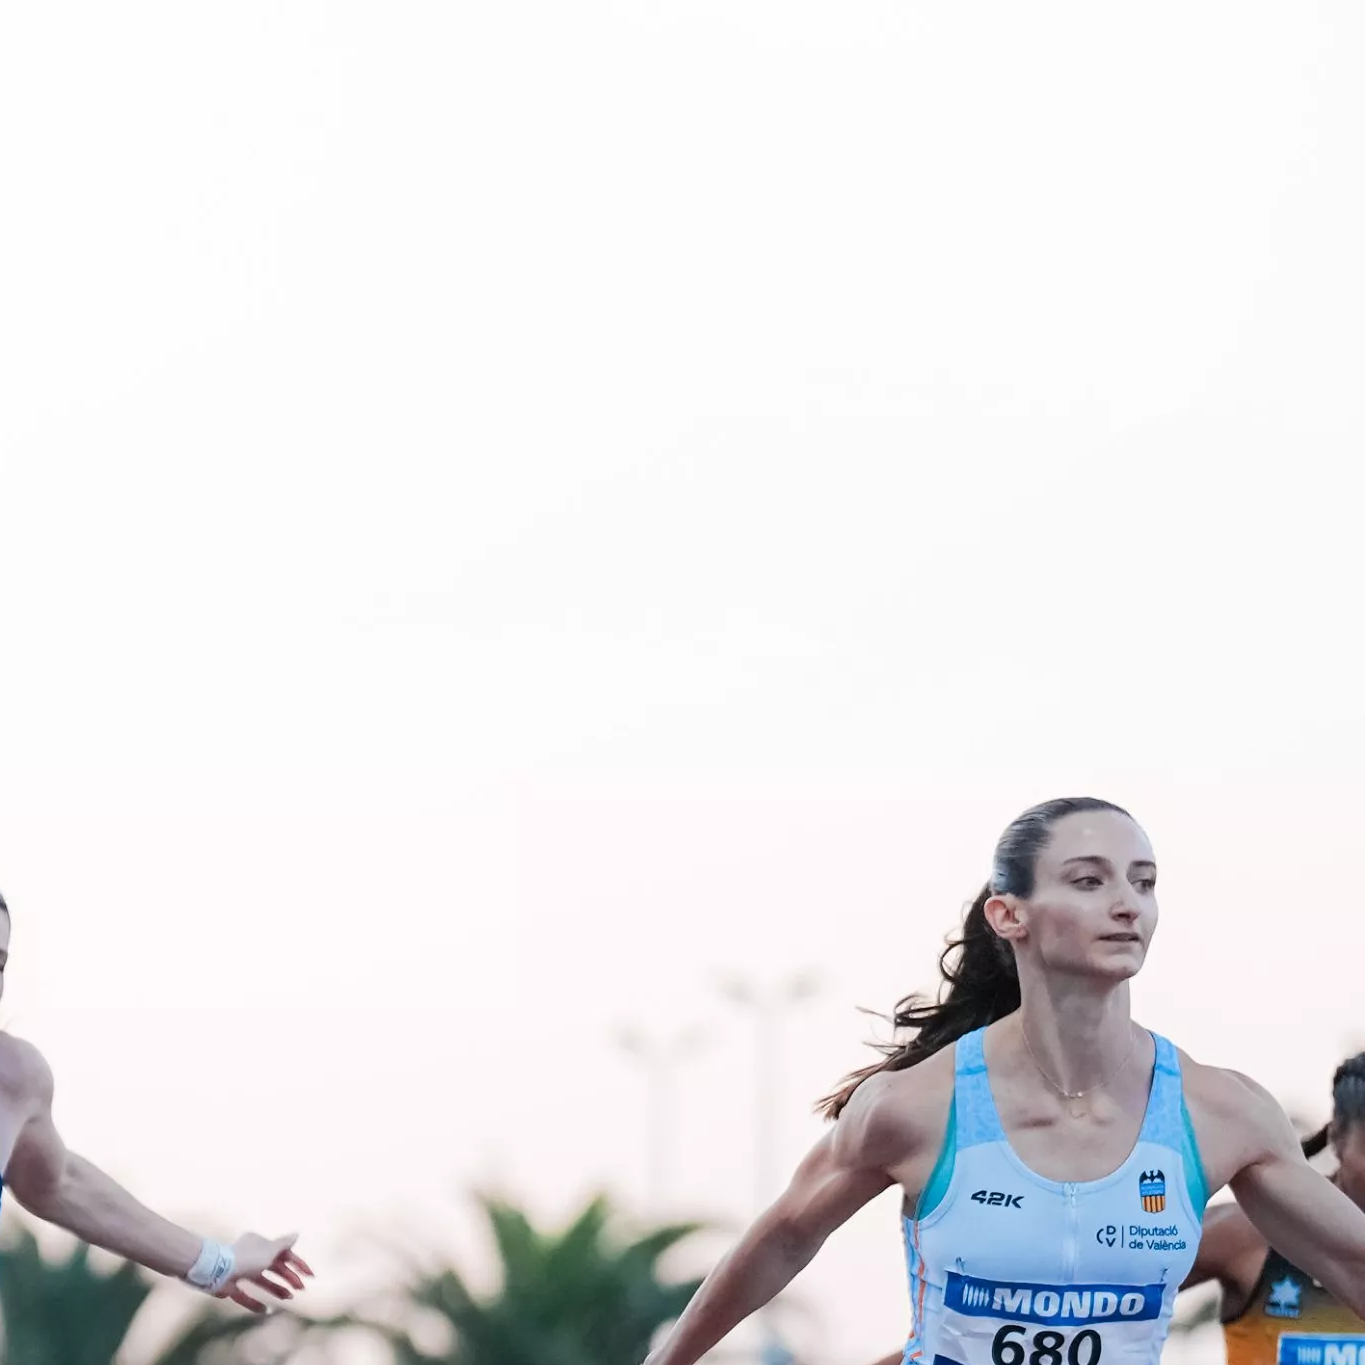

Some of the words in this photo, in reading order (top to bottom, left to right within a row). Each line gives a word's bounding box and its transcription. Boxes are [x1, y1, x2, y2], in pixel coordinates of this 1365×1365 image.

[970, 1190, 1024, 1209] 42K
[1129, 1225, 1178, 1239] Diputació
[1129, 1240, 1143, 1250] de
[1146, 1239, 1187, 1251] València
[992, 1288, 1146, 1319] MONDO
